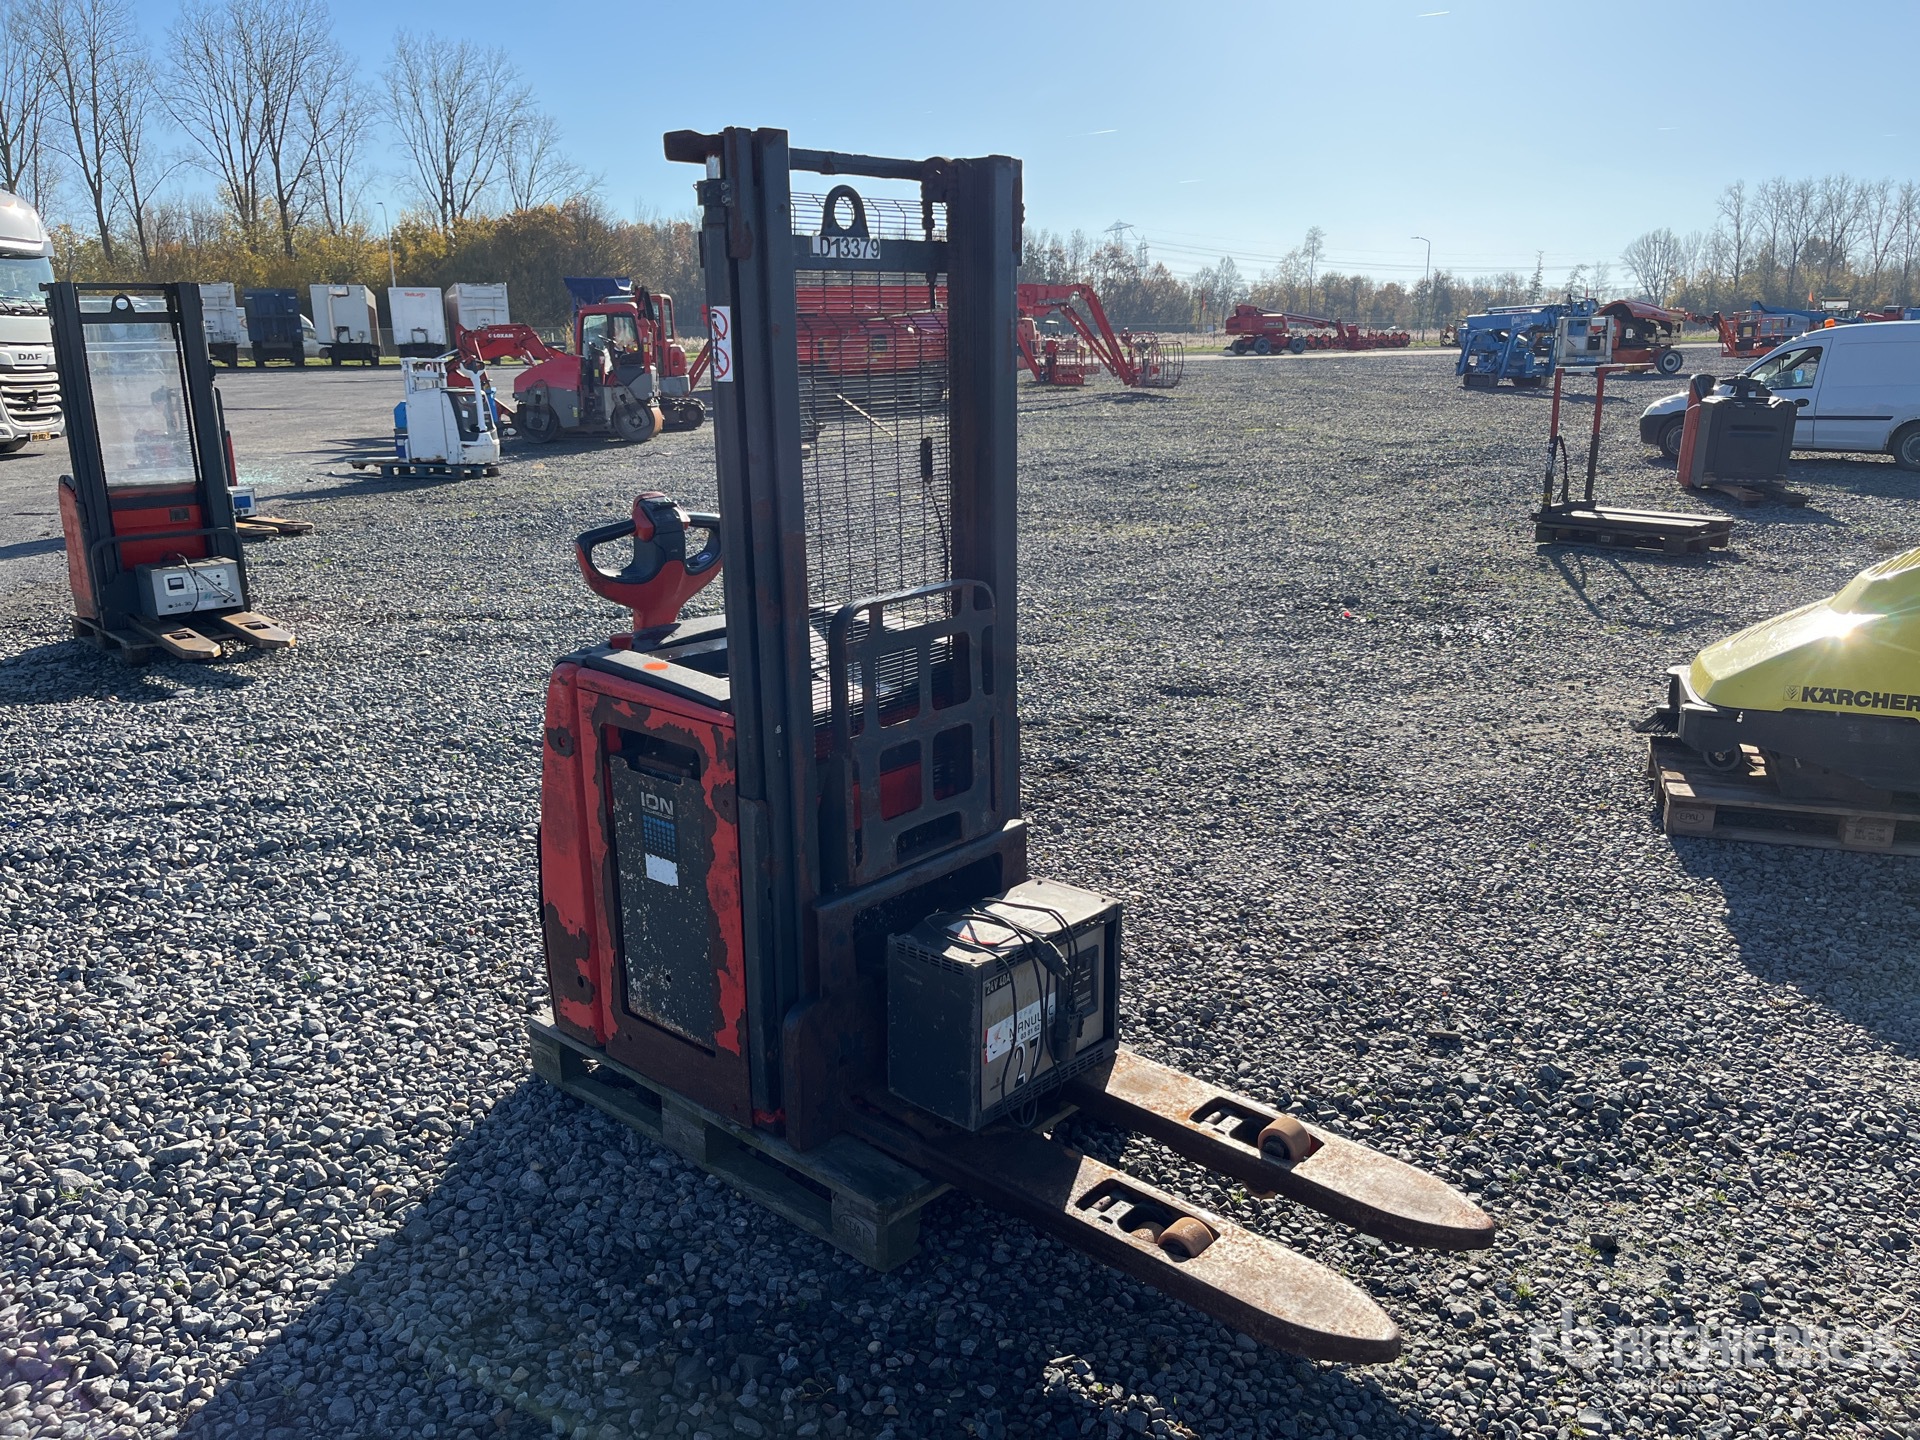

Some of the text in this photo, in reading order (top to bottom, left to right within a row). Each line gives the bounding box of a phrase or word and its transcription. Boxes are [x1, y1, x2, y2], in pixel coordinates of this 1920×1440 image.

[810, 236, 880, 259] LD13379
[18, 353, 42, 361] DAF
[1801, 686, 1920, 712] KÄRCHER
[640, 791, 674, 816] ION
[1009, 1004, 1054, 1039] MANULC
